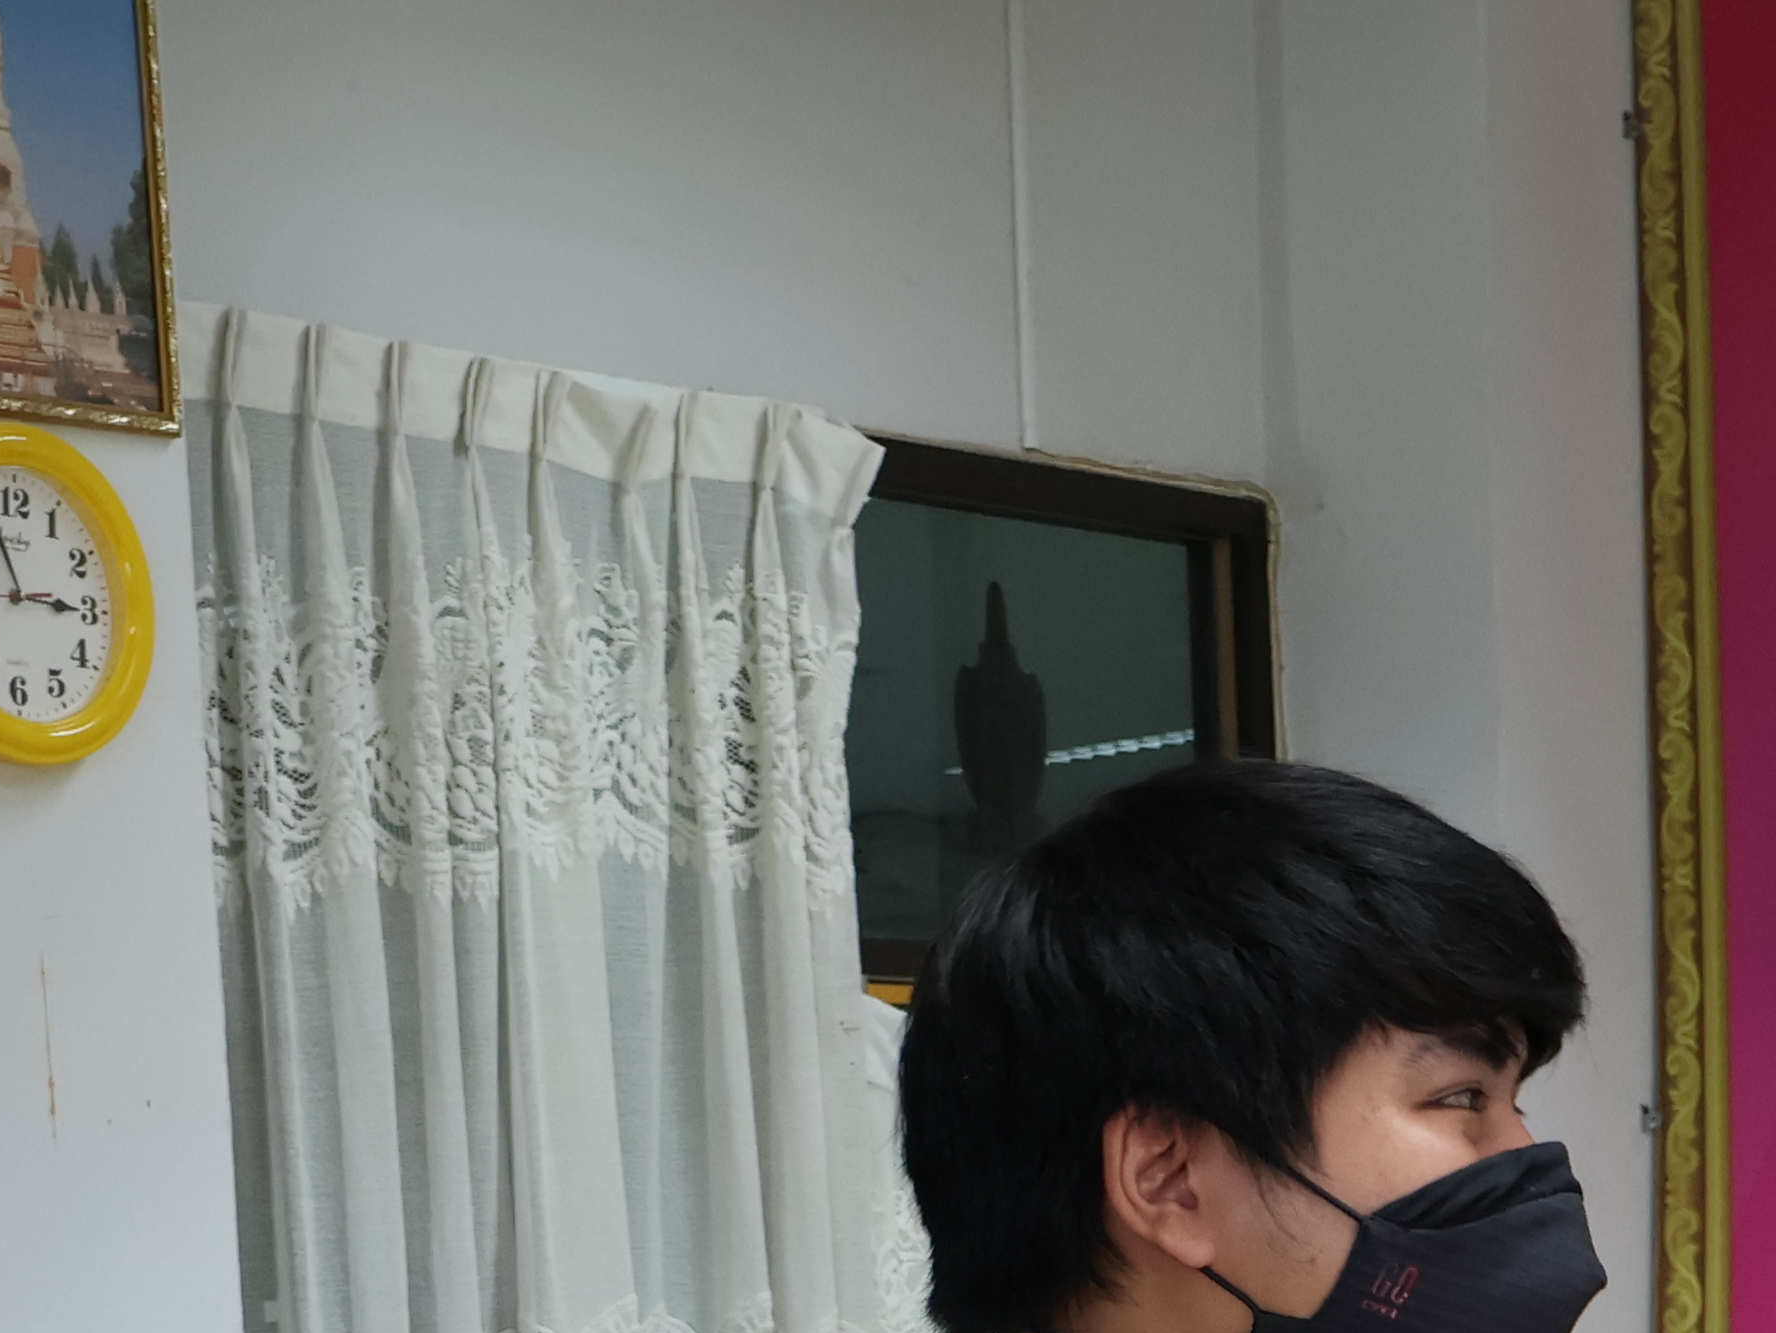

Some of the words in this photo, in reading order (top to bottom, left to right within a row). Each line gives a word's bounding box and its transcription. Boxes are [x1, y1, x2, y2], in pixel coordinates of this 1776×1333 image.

[0, 487, 30, 519] 12
[46, 508, 59, 540] 1
[69, 548, 87, 579] 2
[80, 594, 98, 625] 3
[71, 638, 89, 669] 4
[9, 675, 28, 706] 6
[48, 668, 65, 698] 5
